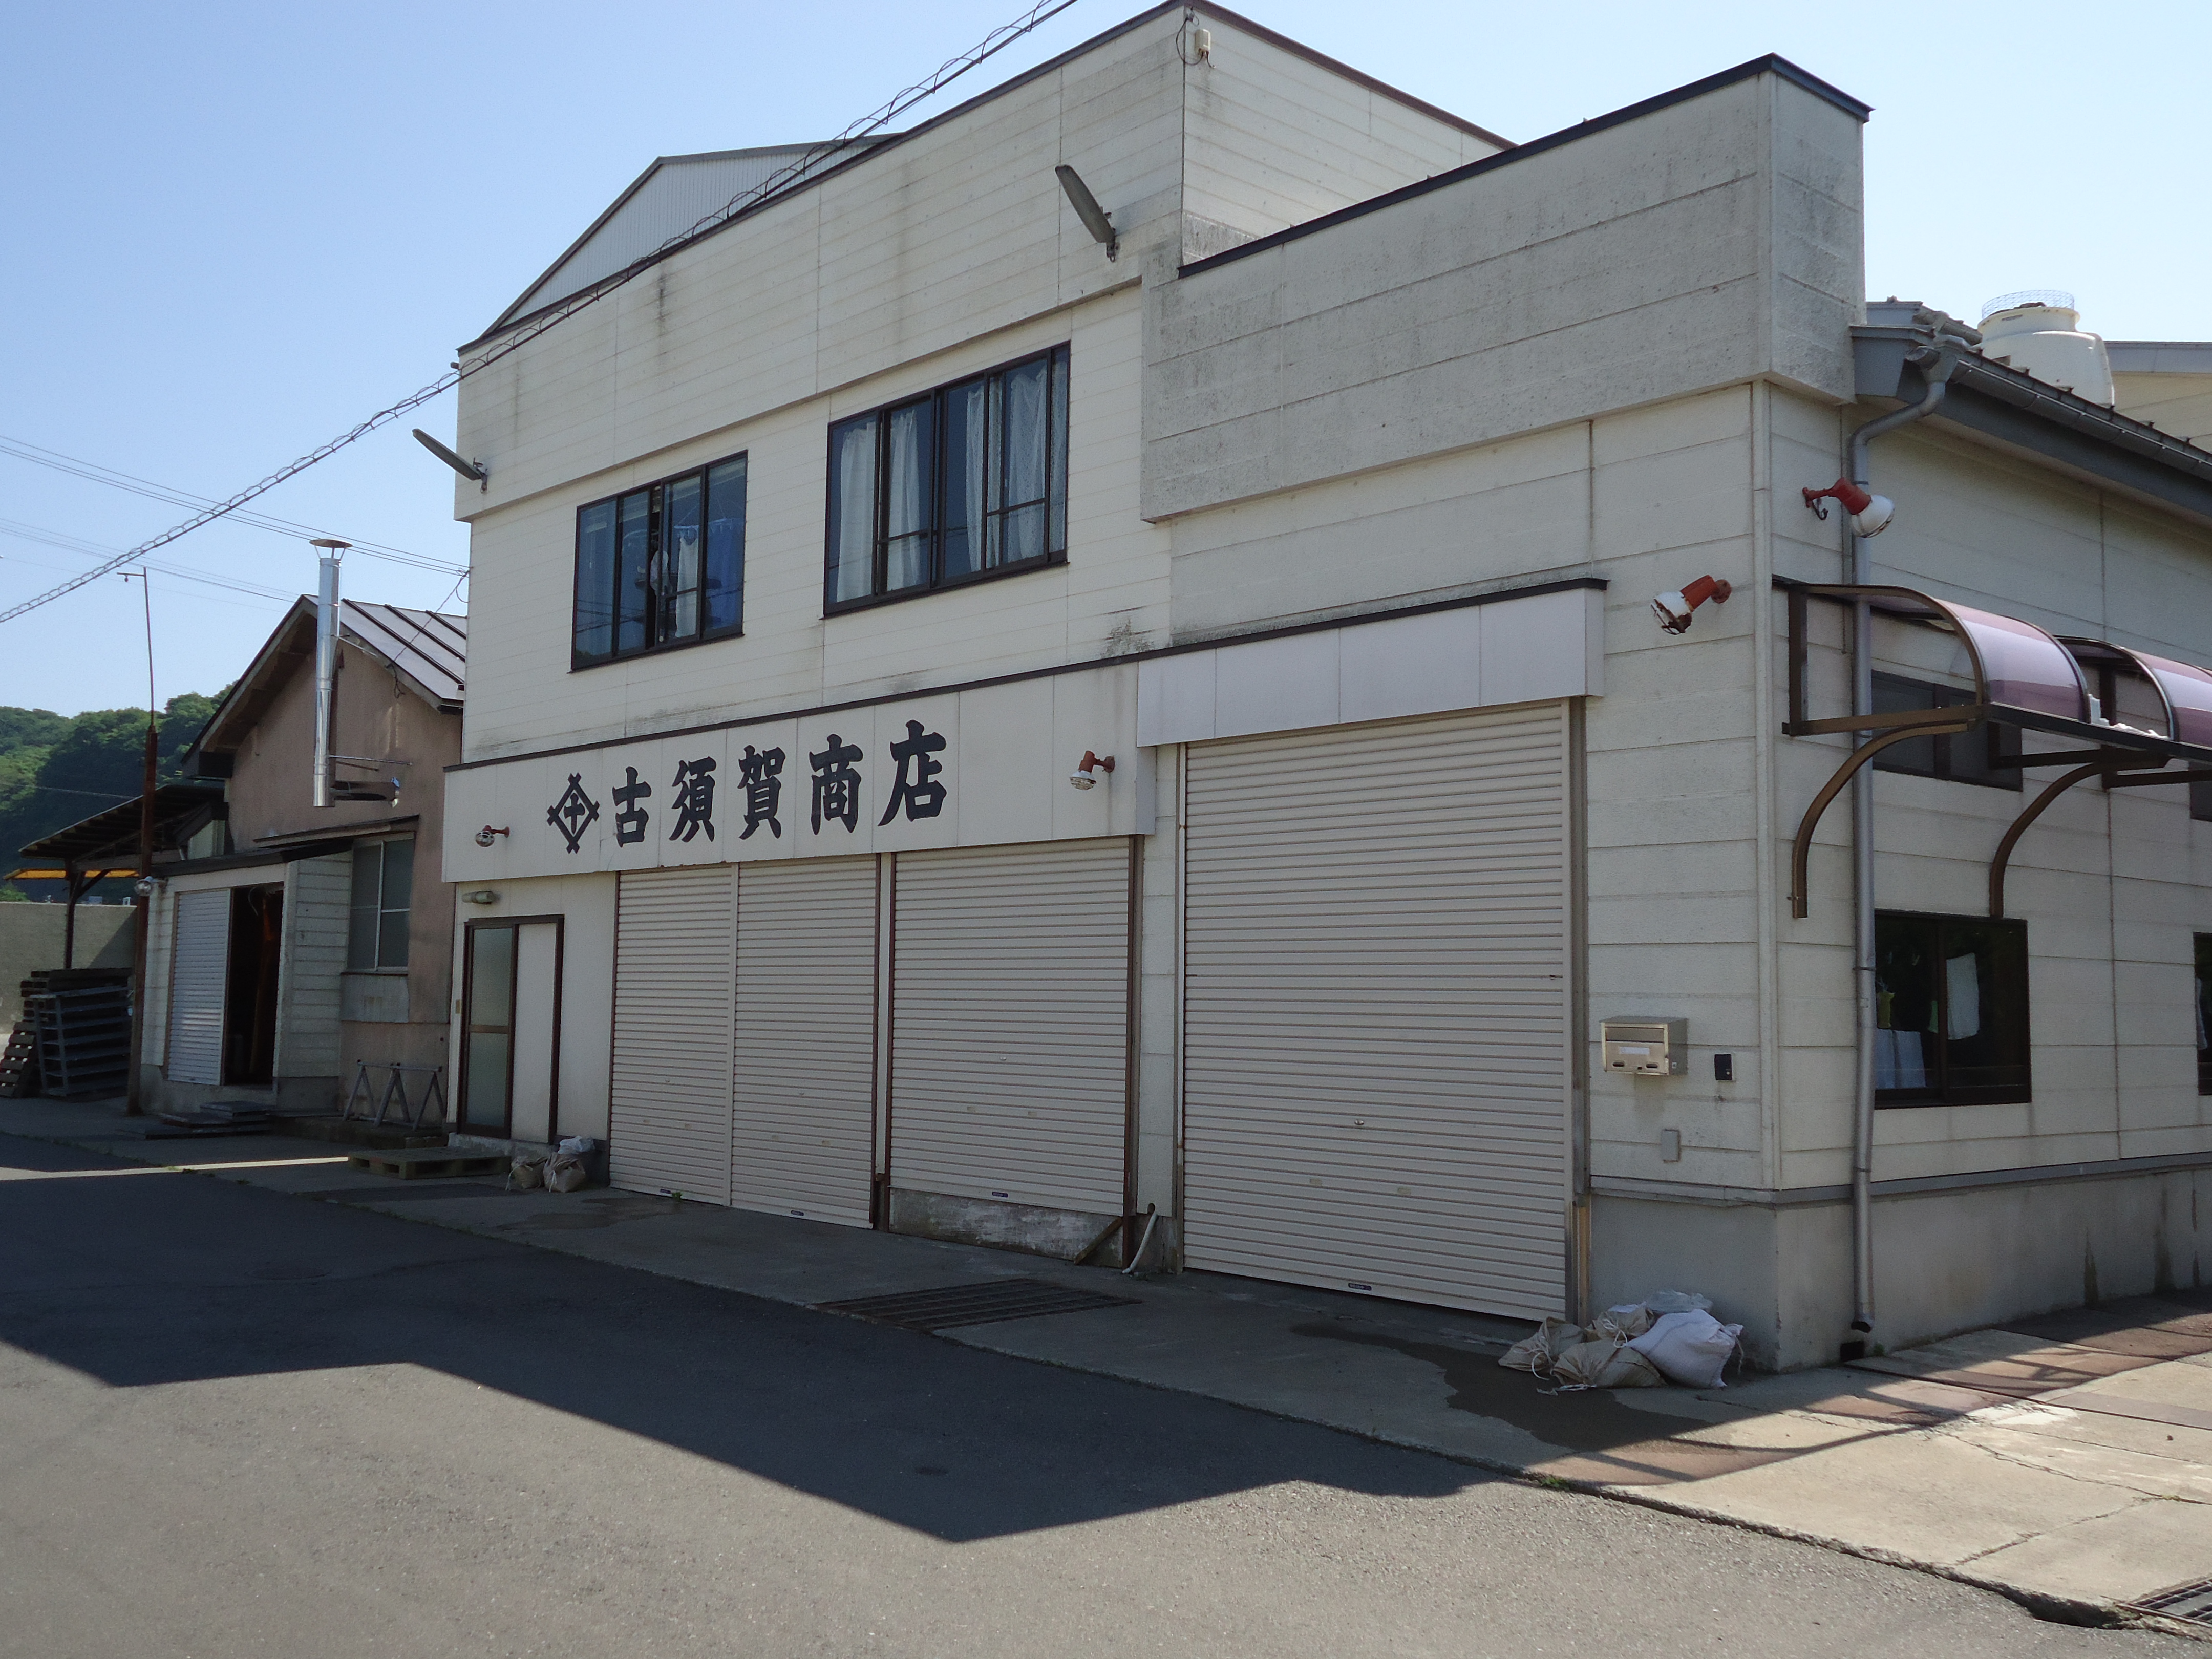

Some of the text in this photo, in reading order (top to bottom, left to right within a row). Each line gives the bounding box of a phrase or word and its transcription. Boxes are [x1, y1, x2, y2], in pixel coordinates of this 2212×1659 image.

[612, 719, 947, 848] 古須賀商店
